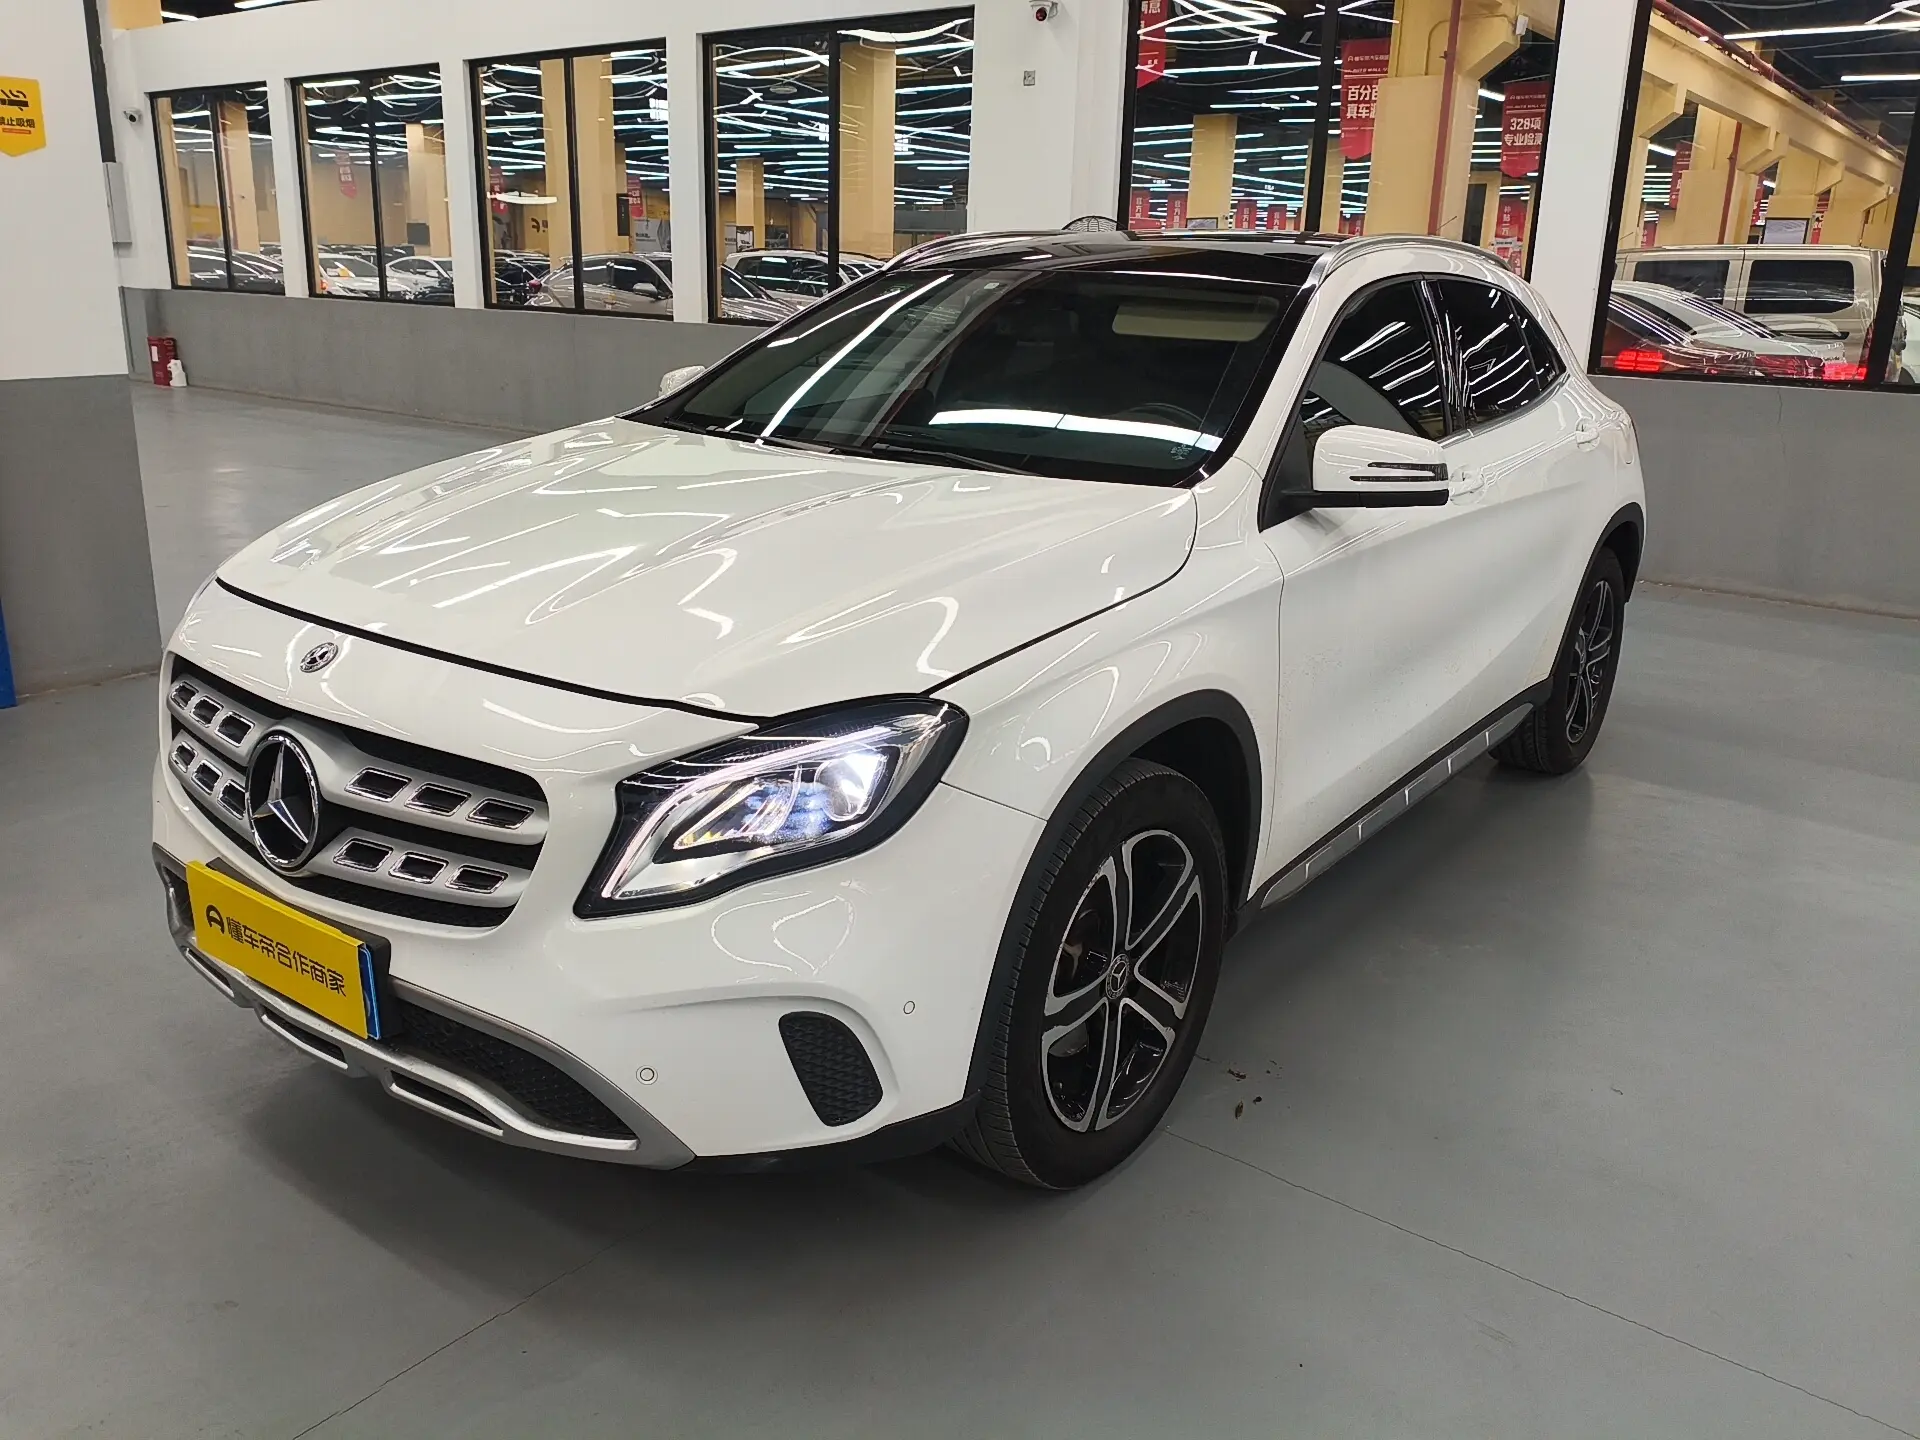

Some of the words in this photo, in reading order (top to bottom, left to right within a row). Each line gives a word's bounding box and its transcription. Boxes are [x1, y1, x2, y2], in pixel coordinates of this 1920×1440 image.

[1510, 117, 1541, 131] 328项
[226, 916, 347, 997] 懂车帝合作商家
